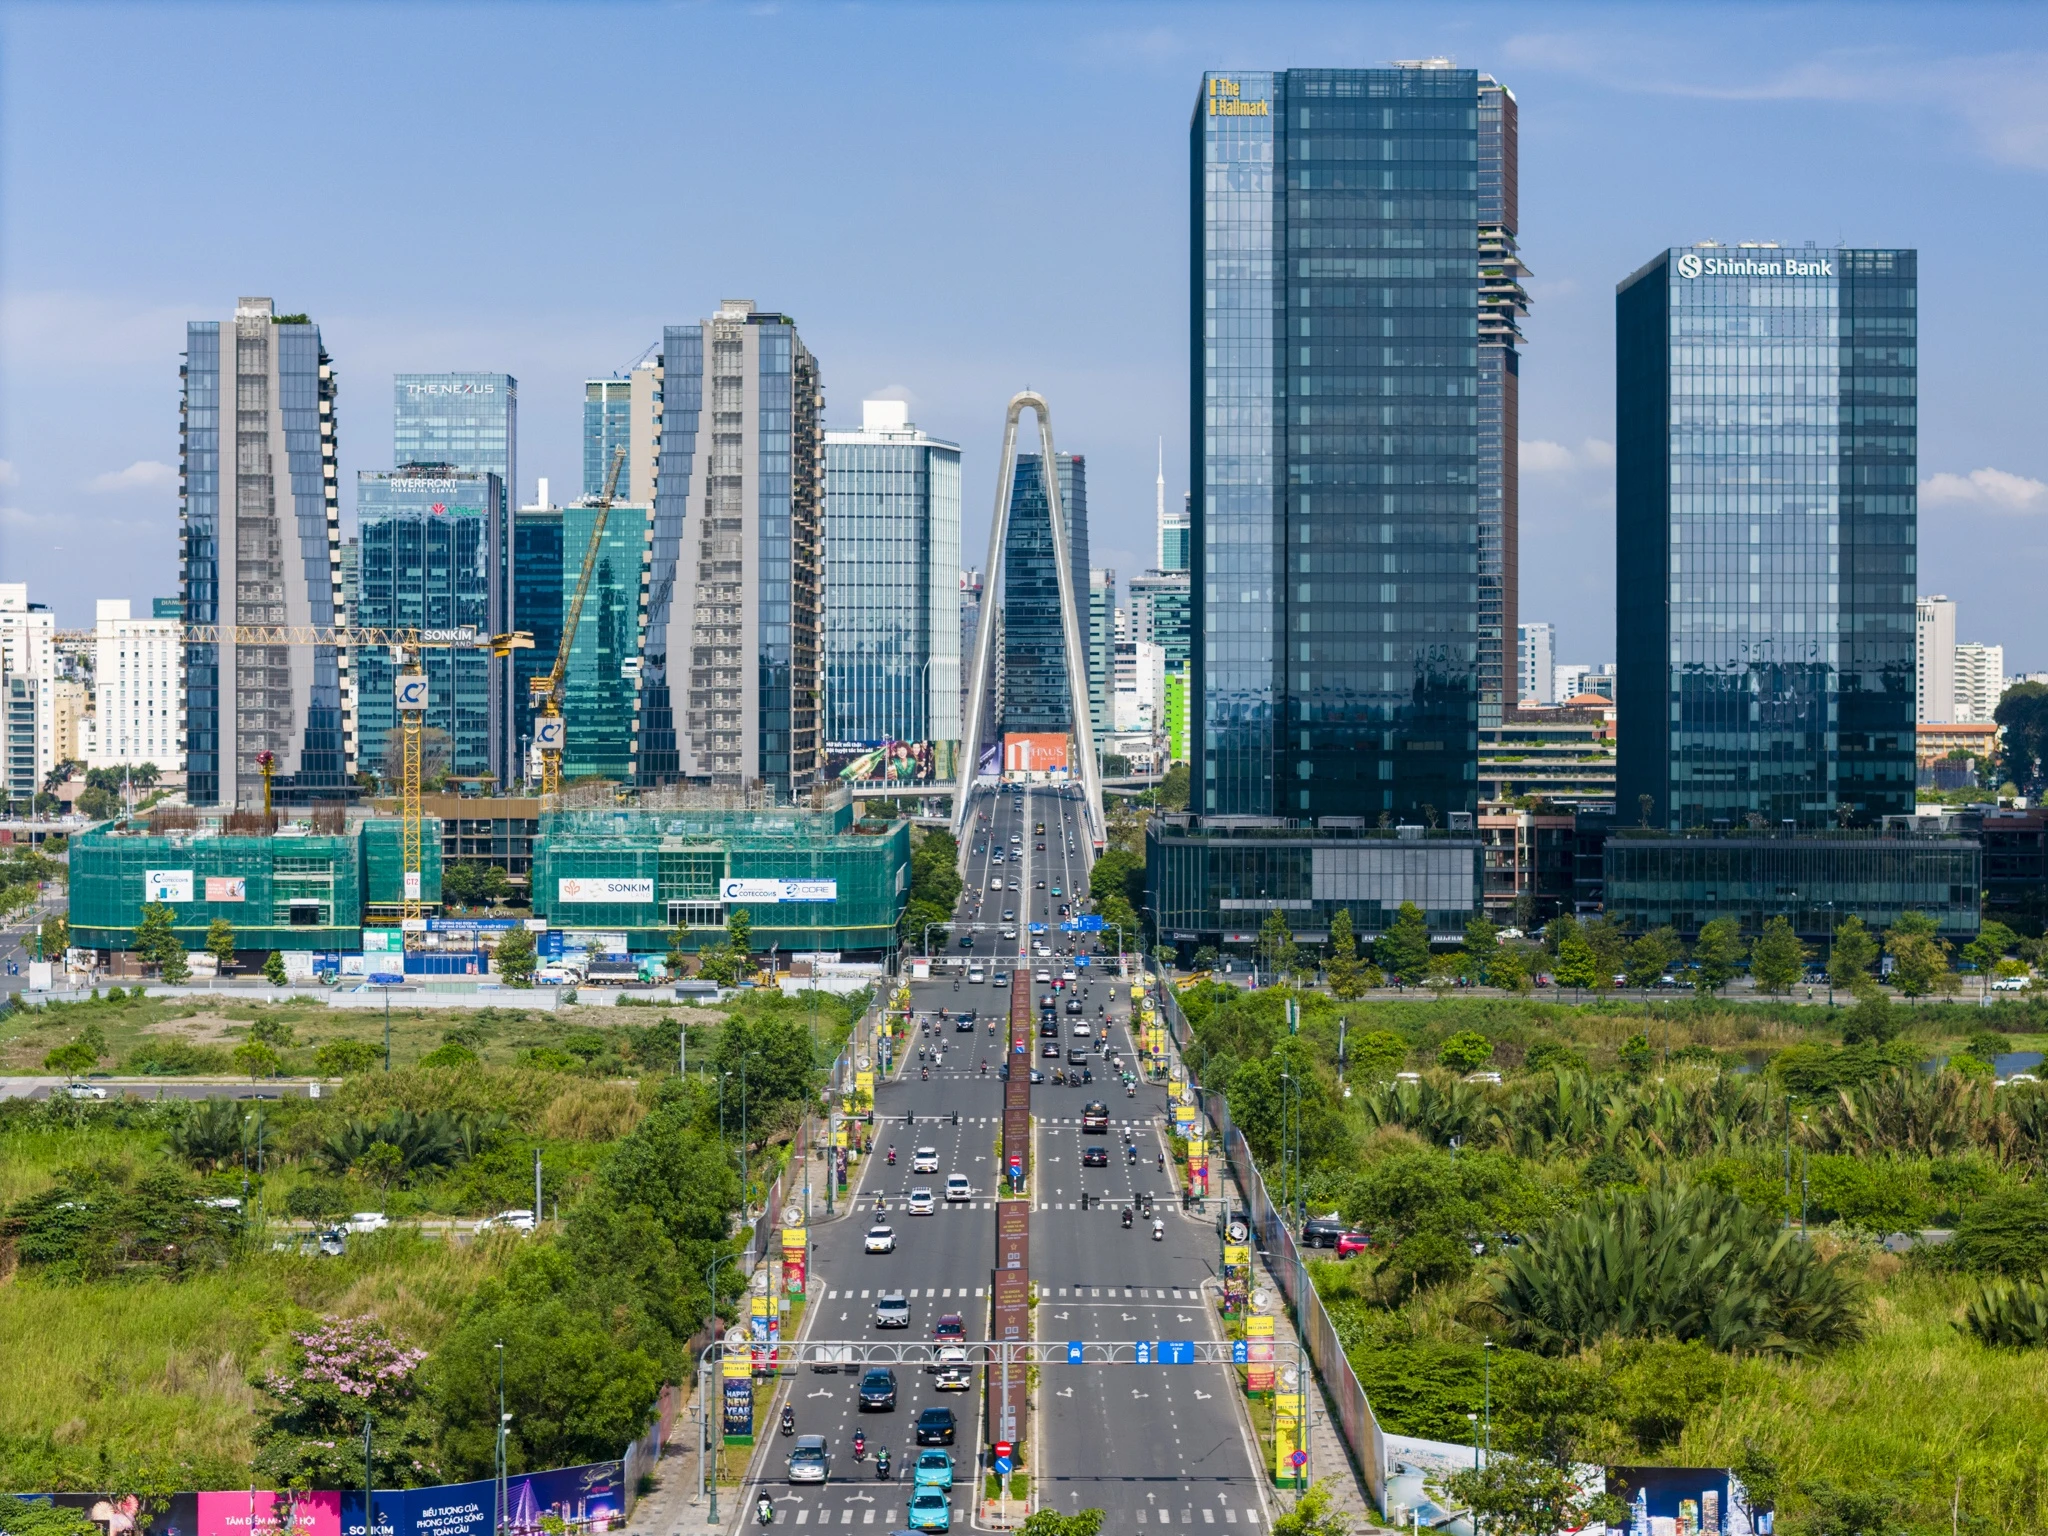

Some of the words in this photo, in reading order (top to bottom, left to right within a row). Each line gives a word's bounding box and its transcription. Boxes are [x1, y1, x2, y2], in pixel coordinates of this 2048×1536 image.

[1220, 79, 1240, 96] The
[1219, 98, 1269, 116] Hallmark
[1704, 258, 1781, 276] Shinhan
[1785, 259, 1833, 276] Bank
[406, 384, 438, 394] THE
[441, 384, 495, 394] NEXUS
[390, 478, 458, 489] RIVERFRONT
[424, 630, 472, 641] SONKIM
[406, 878, 419, 886] CT2
[607, 883, 650, 892] SONKIM
[726, 1390, 750, 1398] HAPPY
[727, 1398, 750, 1406] NEW
[726, 1407, 750, 1415] YEAR
[728, 1415, 749, 1423] 2026
[464, 1502, 479, 1513] CỦA
[225, 1515, 244, 1526] TÂM
[299, 1515, 316, 1527] HỘI
[416, 1517, 443, 1528] PHONG
[443, 1514, 464, 1526] CÁCH
[464, 1512, 484, 1524] SỐNG
[454, 1525, 470, 1534] CẦU
